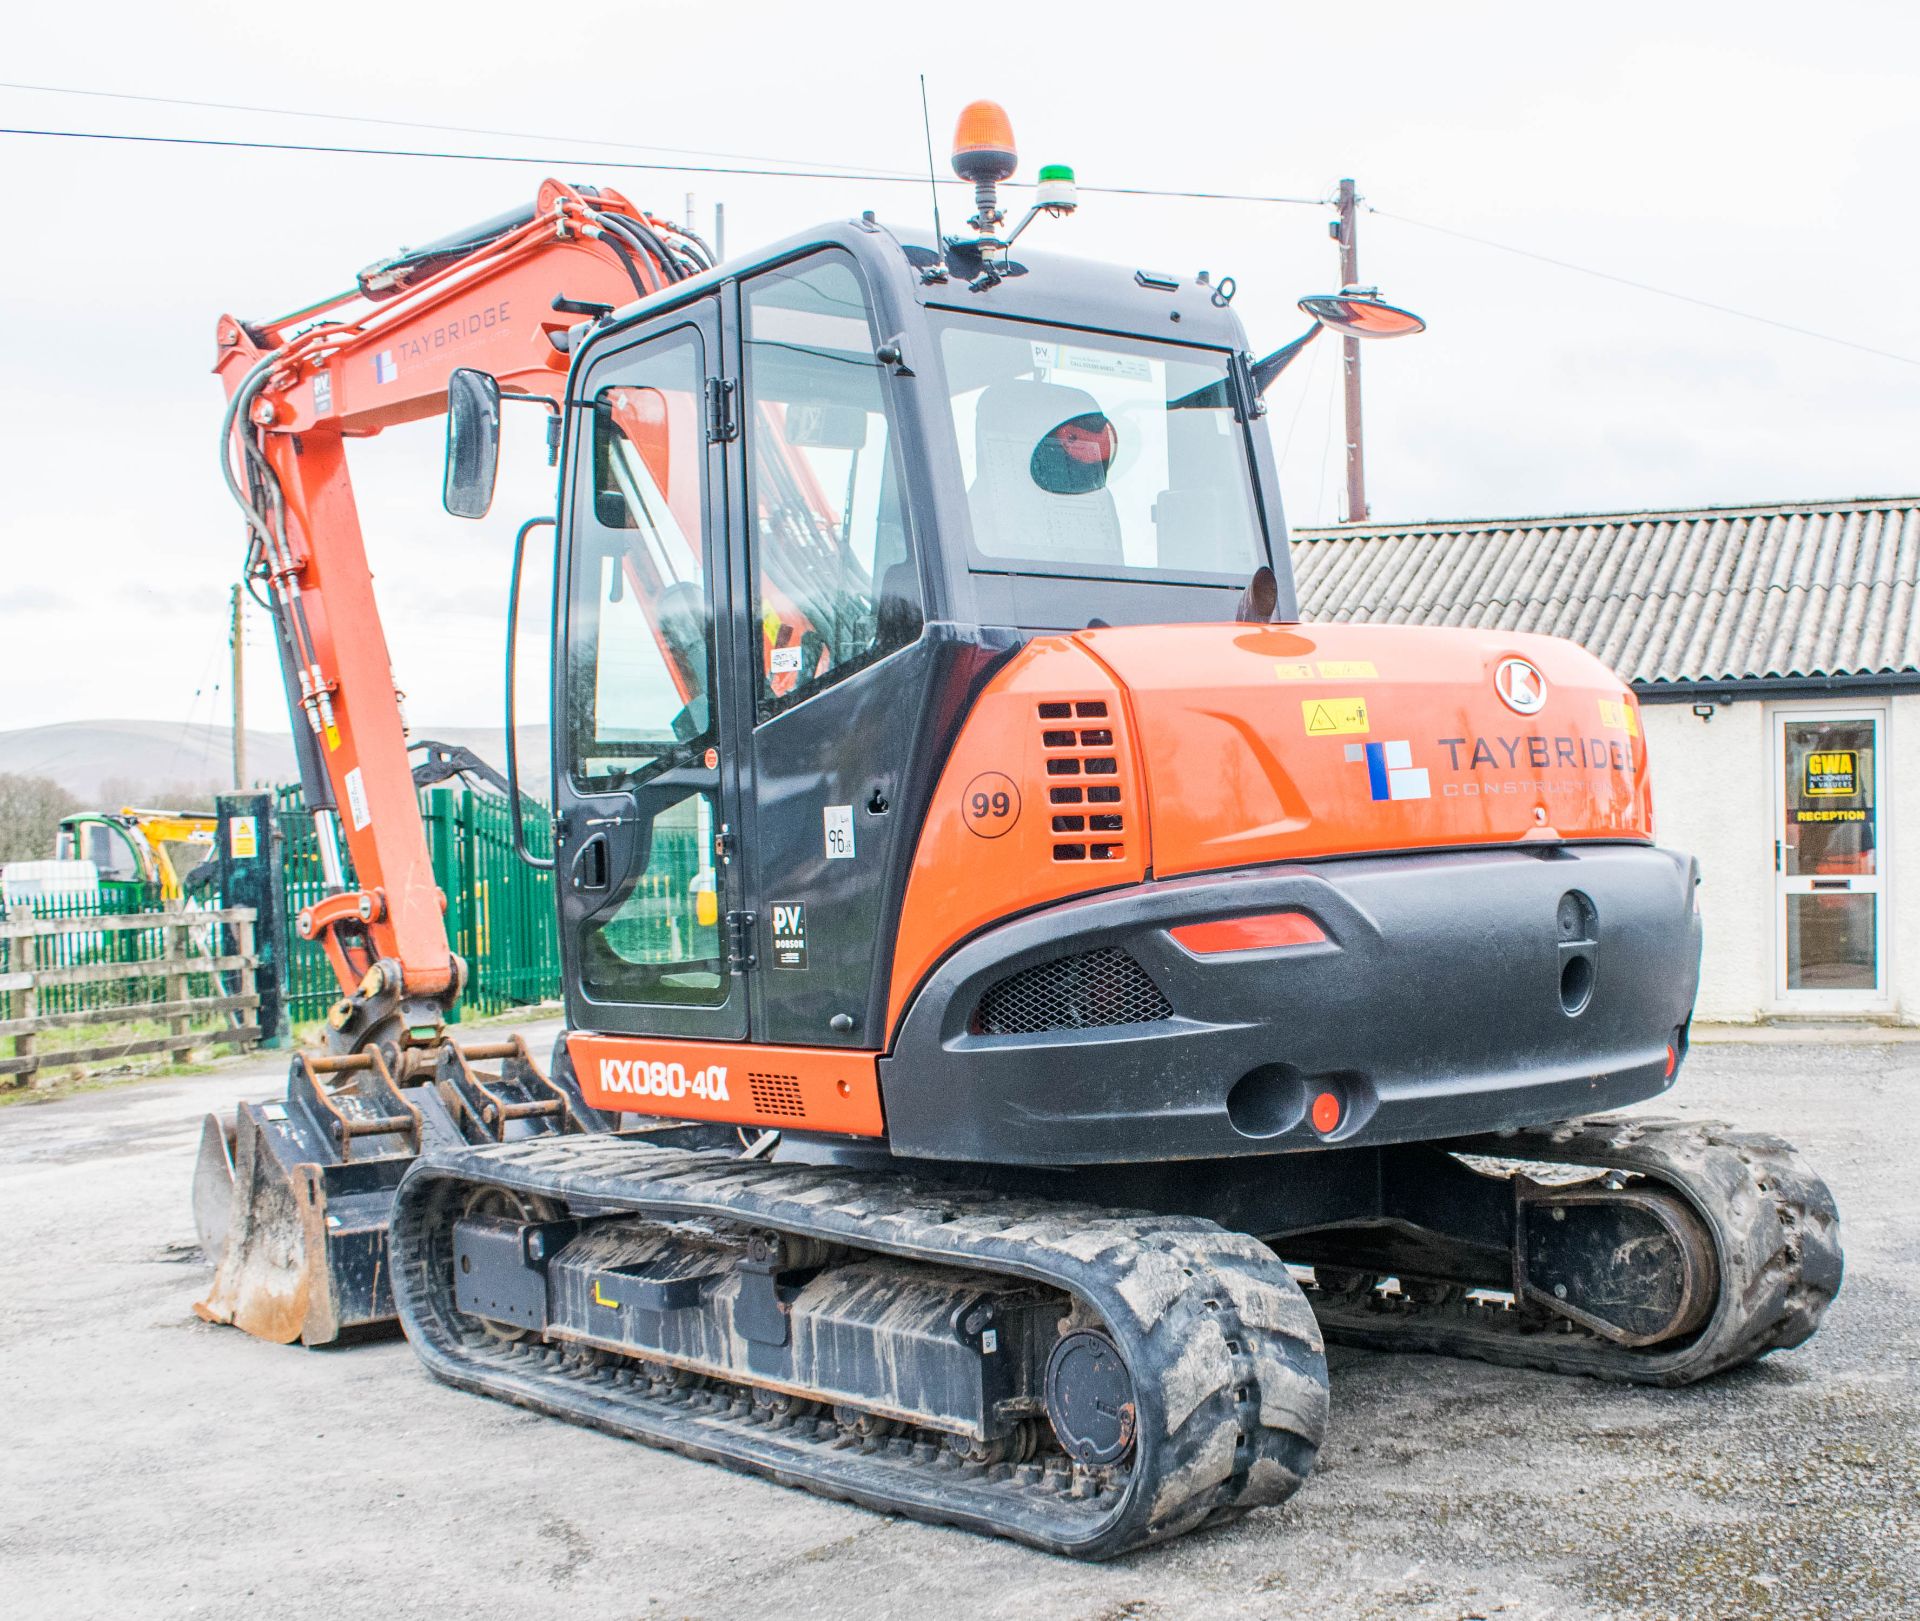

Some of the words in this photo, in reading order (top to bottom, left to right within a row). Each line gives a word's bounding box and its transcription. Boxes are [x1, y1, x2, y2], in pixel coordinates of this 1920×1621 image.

[400, 302, 511, 361] TAYBRIDGE
[1438, 736, 1636, 773] TAYBRIDGE
[1809, 754, 1853, 775] GWA
[972, 792, 1010, 818] 99
[1797, 810, 1866, 822] RECEPTION
[829, 829, 844, 853] 96
[772, 906, 803, 935] P.V.
[775, 939, 805, 949] DOBSON
